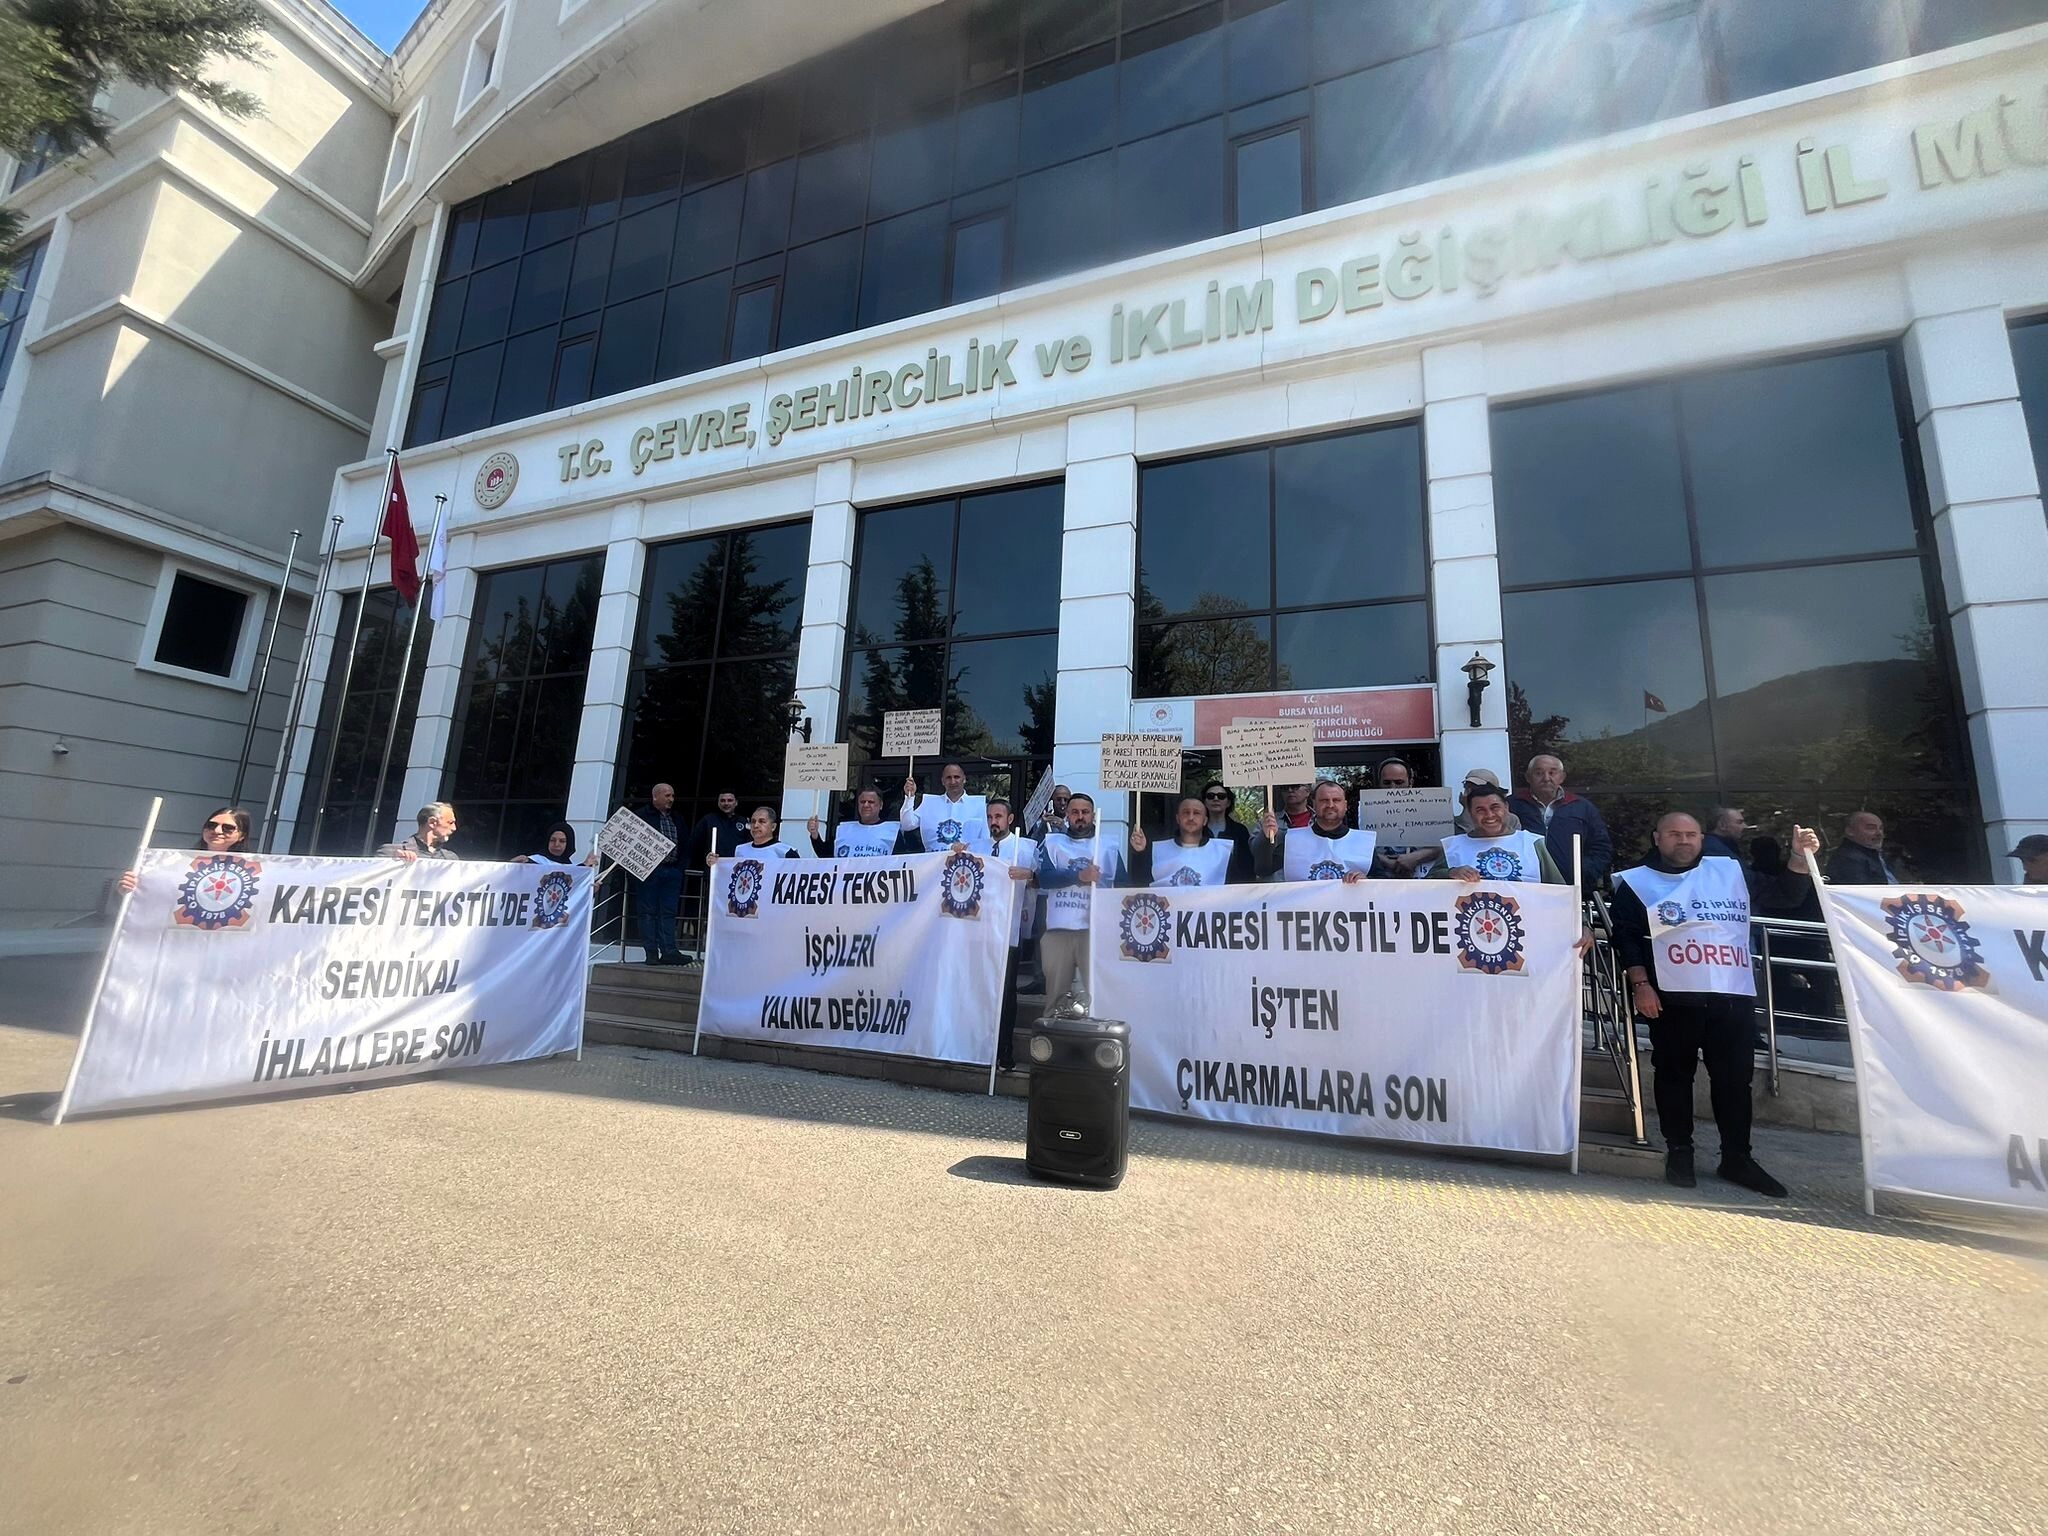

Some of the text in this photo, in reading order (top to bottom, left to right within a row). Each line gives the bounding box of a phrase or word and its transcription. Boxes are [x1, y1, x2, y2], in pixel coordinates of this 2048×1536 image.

[558, 439, 611, 481] T.C.
[629, 402, 757, 474] ÇEVRE,
[765, 337, 1019, 446] ŞEHİRCİLİK
[1035, 333, 1091, 378] ve
[1110, 279, 1274, 365] İKLİM
[1796, 137, 1888, 217] İL
[1279, 707, 1306, 717] BURSA
[1327, 727, 1383, 739] MÜDÜRLÜĞÜ
[1386, 789, 1424, 797] MASAK
[269, 878, 392, 926] KARESİ
[399, 883, 530, 928] TEKSTİL'DE
[770, 864, 839, 906] KARESİ
[842, 859, 919, 905] TEKSTİL
[1691, 899, 1709, 910] ÖZ
[804, 925, 880, 979] İŞÇİLERİ
[1175, 901, 1269, 954] KARESİ
[1411, 911, 1451, 955] DE
[320, 950, 461, 1001] SENDİKAL
[760, 989, 911, 1036] YALNIZ DEĞİLDİR
[1251, 976, 1339, 1038] İŞ'TEN
[252, 1020, 486, 1084] İHLALLERE SON
[1176, 1057, 1448, 1123] ÇIKARMALARA SON
